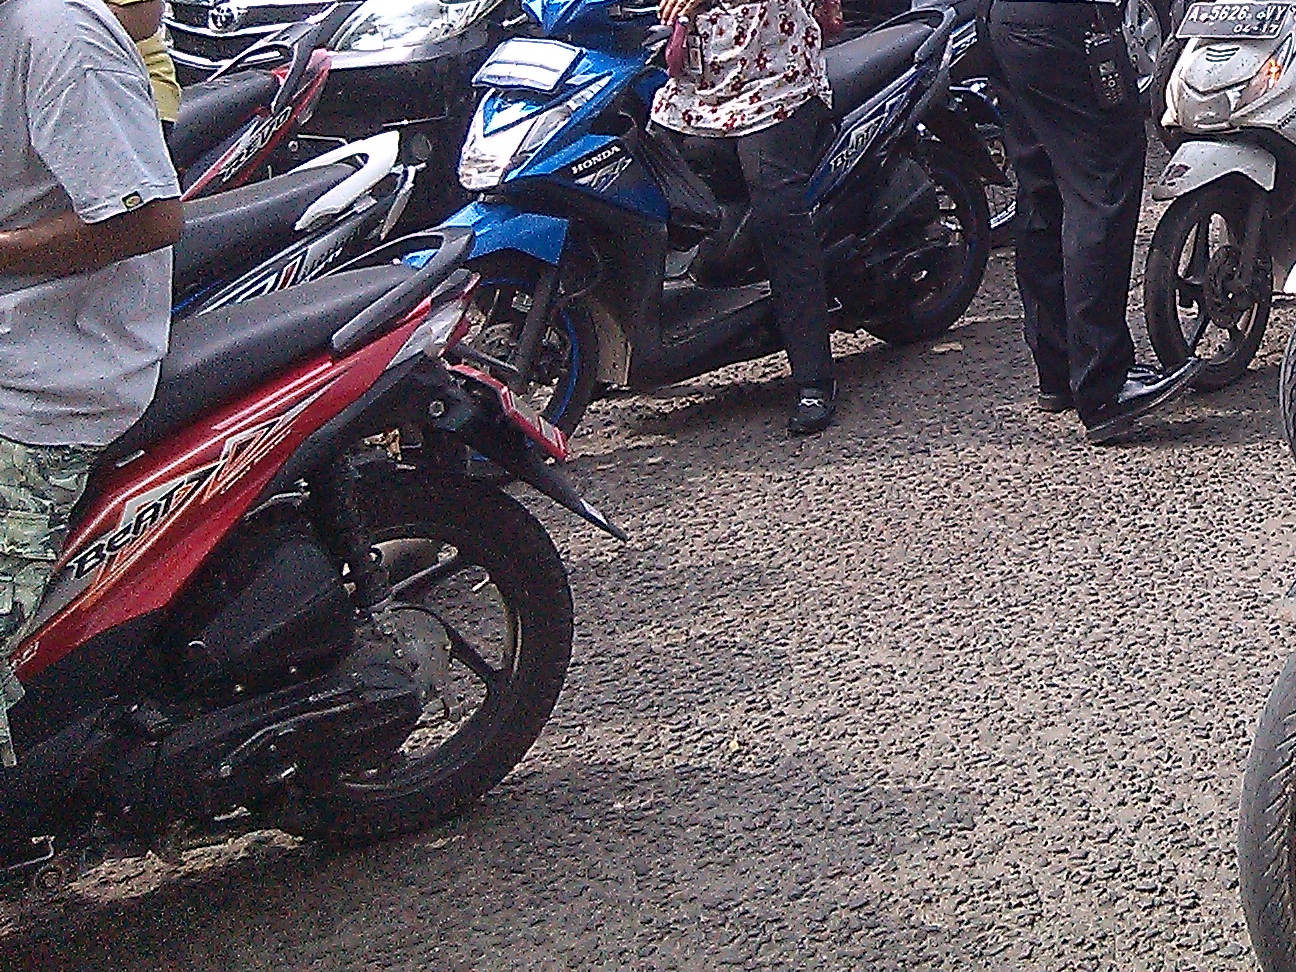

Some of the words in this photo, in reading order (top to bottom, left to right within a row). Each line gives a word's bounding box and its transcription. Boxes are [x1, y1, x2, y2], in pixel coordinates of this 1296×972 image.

[1187, 7, 1202, 21] A
[1210, 4, 1247, 21] 5626
[1265, 5, 1287, 21] VY
[571, 144, 622, 175] HONDA
